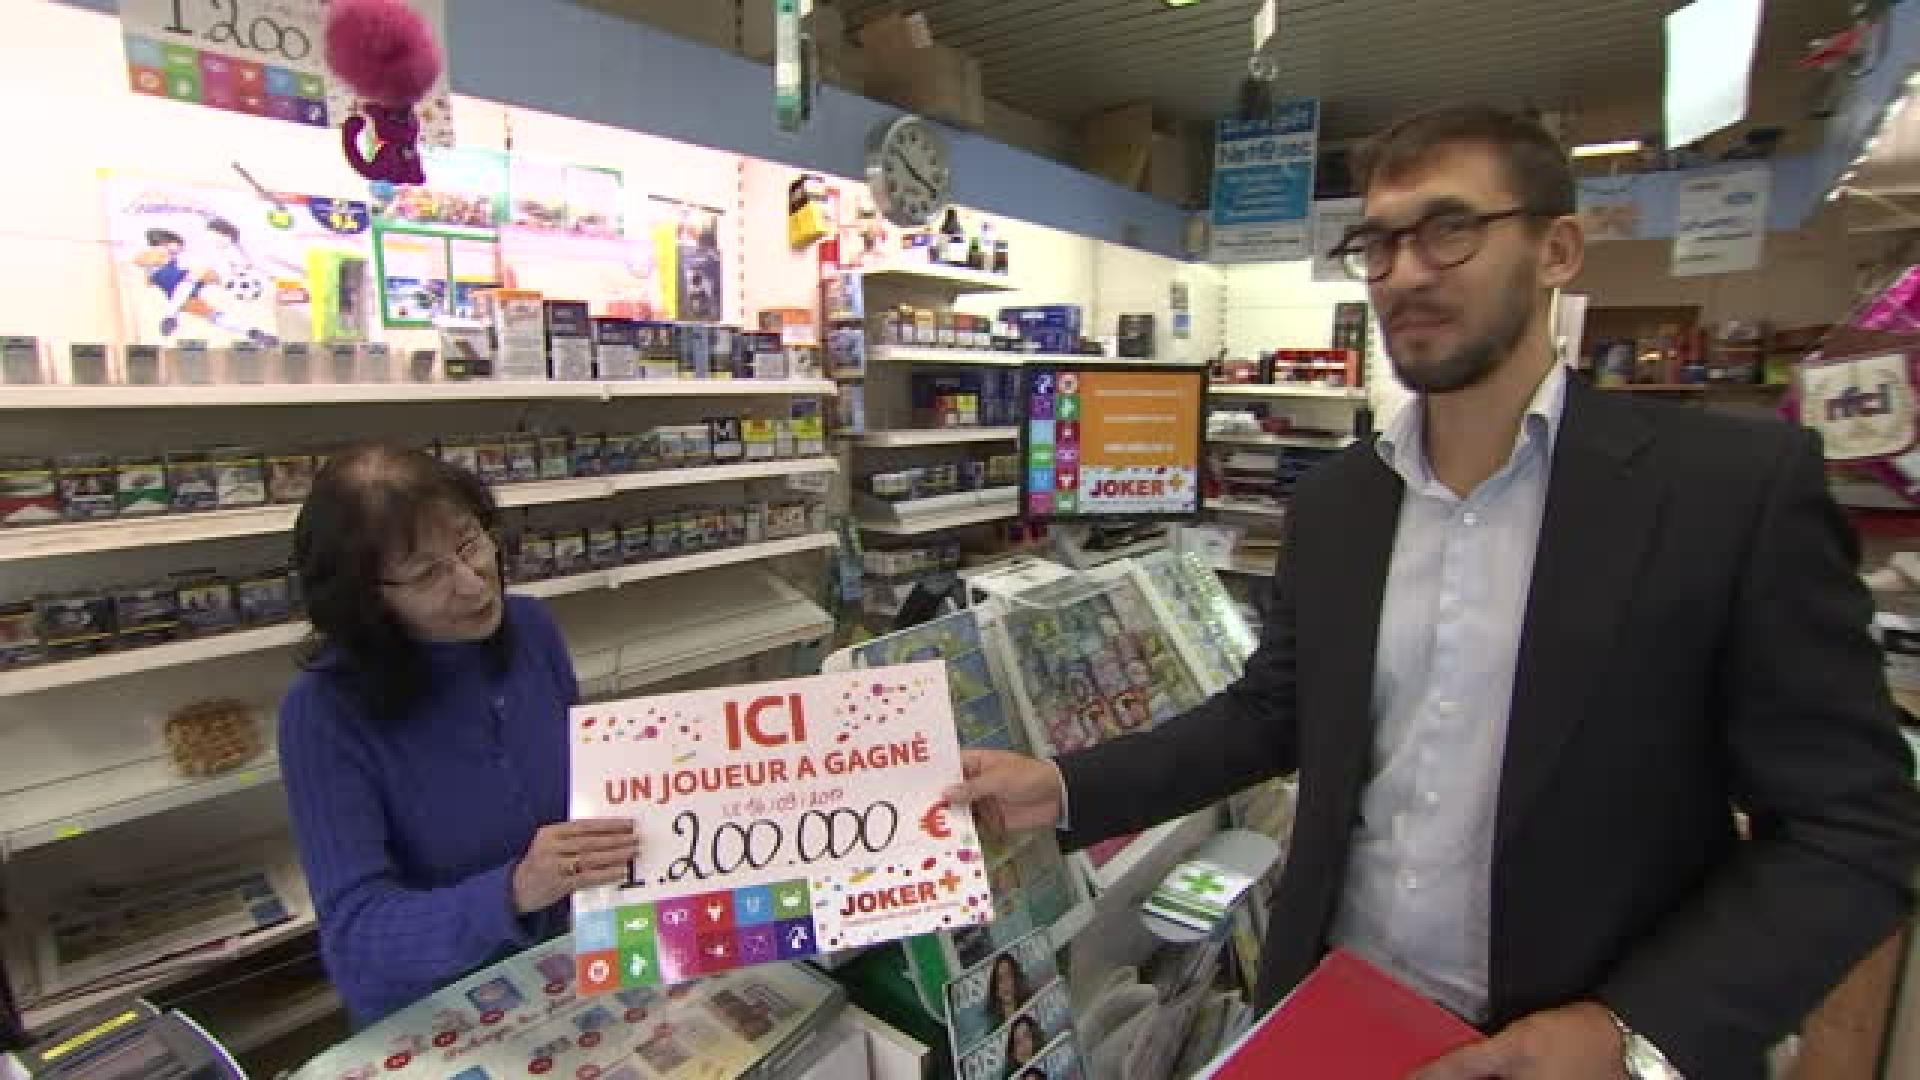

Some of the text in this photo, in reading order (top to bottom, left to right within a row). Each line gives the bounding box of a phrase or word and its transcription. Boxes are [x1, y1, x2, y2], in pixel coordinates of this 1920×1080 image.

[722, 693, 808, 750] ICI
[605, 776, 652, 804] UN
[656, 758, 789, 804] JOUEUR
[797, 756, 817, 780] A
[919, 794, 952, 838] €
